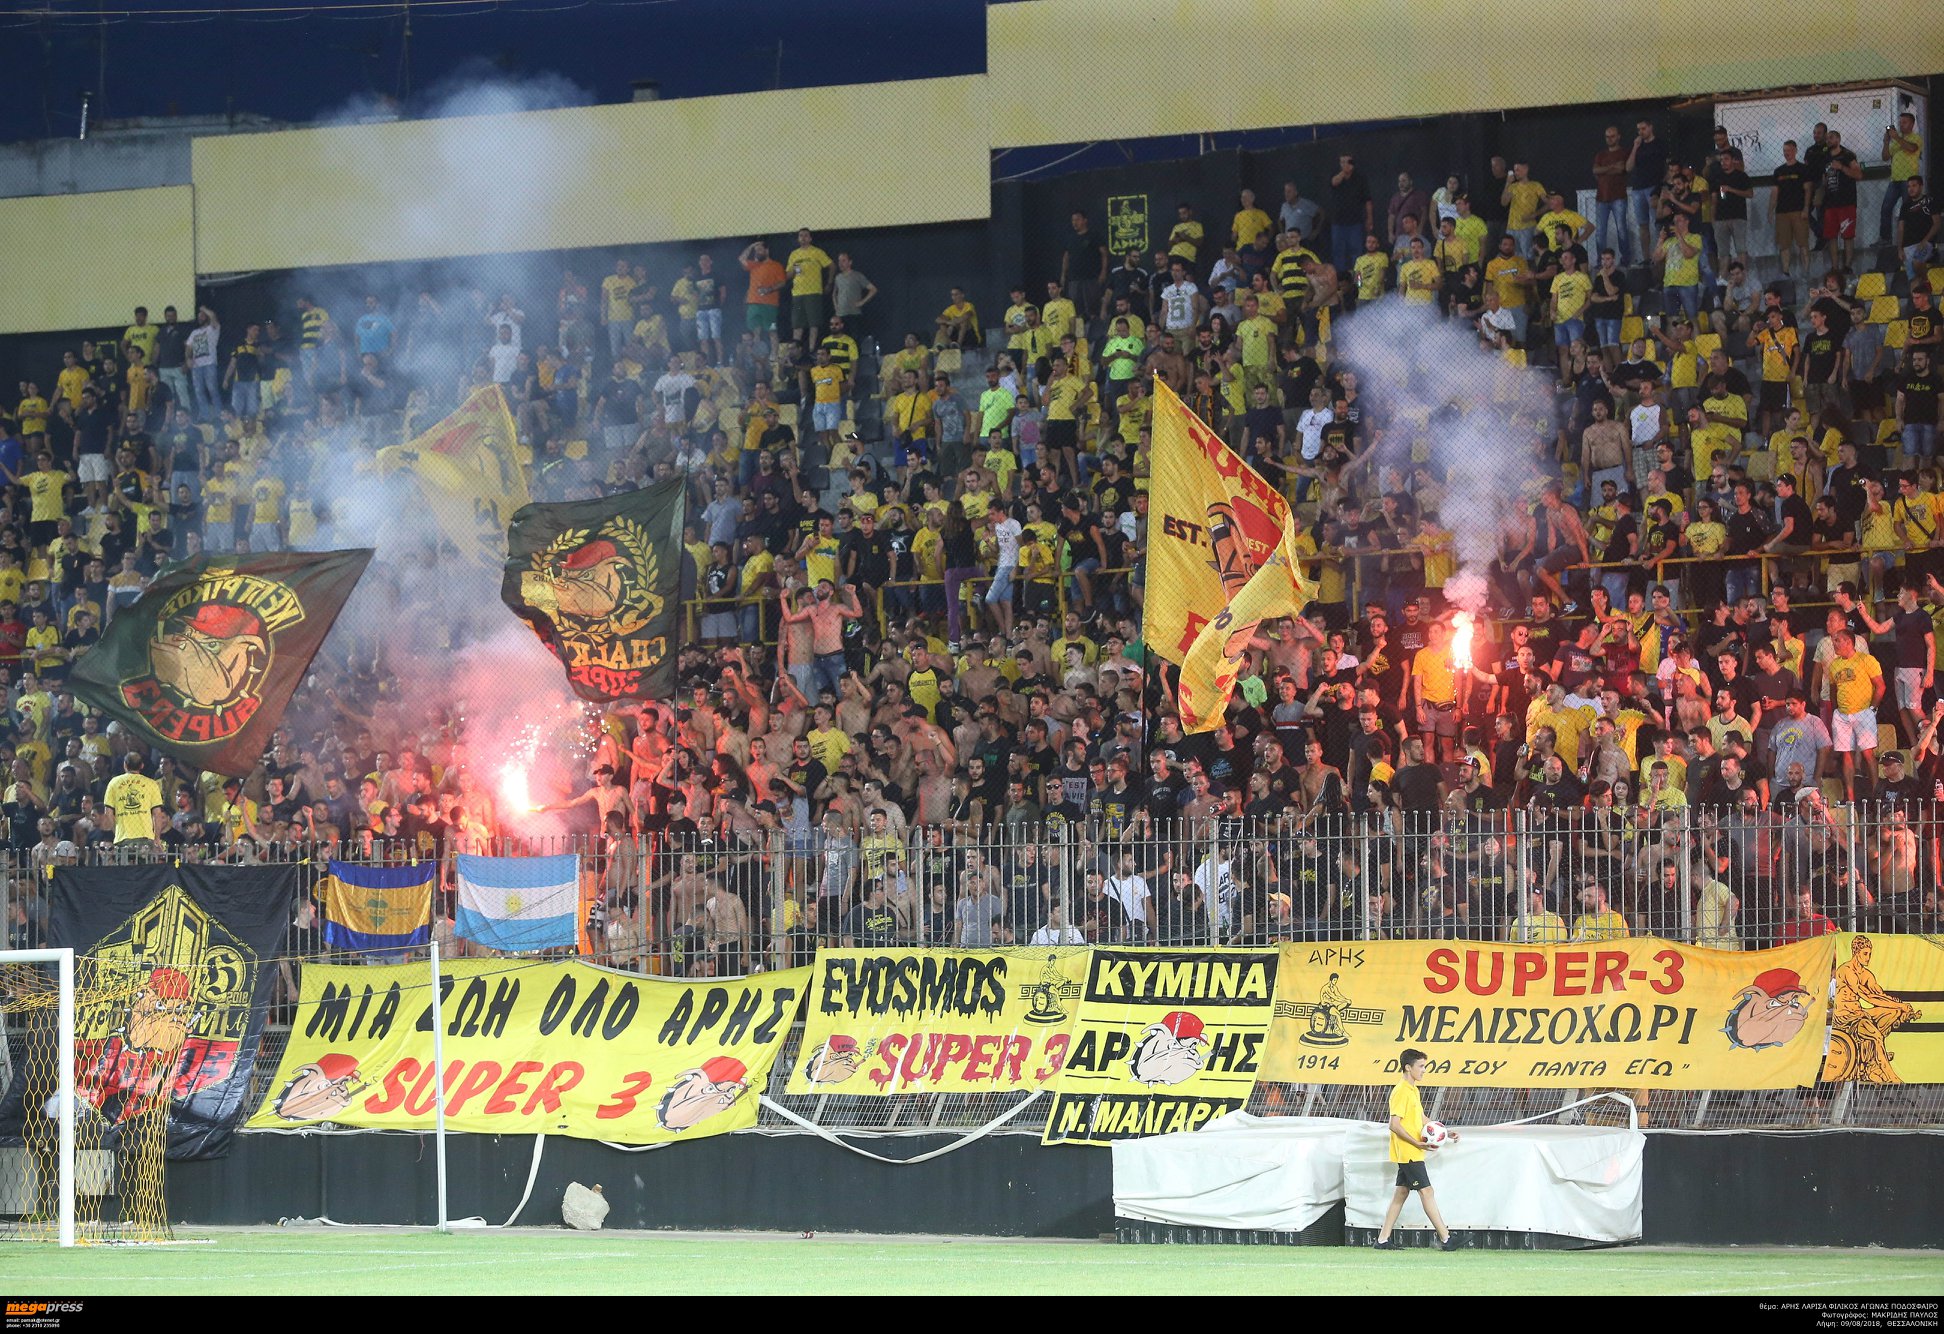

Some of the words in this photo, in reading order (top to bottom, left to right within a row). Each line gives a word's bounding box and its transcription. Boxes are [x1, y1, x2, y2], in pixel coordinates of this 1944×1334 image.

[1308, 947, 1365, 968] ΑΡΗΣ
[1423, 947, 1685, 997] SUPER-3
[227, 991, 248, 1003] 2018
[820, 956, 1008, 1024] EVOSMOS
[1095, 959, 1268, 999] ΚΥΜΙΝΑ
[305, 981, 400, 1043] ΜΙΑ
[416, 974, 520, 1038] ΖΩΗ
[539, 973, 640, 1041] ΟΛΟ
[658, 987, 795, 1046] ΑΡΗΣ
[1395, 1002, 1698, 1045] ΜΕΛΙΣΣΟΧΩΡΙ
[869, 1033, 1032, 1092] SUPER
[1034, 1034, 1071, 1083] 3
[1297, 1055, 1341, 1071] 1914
[1459, 1059, 1507, 1075] ΣΟΥ
[1528, 1060, 1607, 1076] ΠΑΝΤΑ
[364, 1057, 584, 1117] SUPER
[596, 1071, 652, 1119] 3
[1057, 1101, 1086, 1133] Ν.
